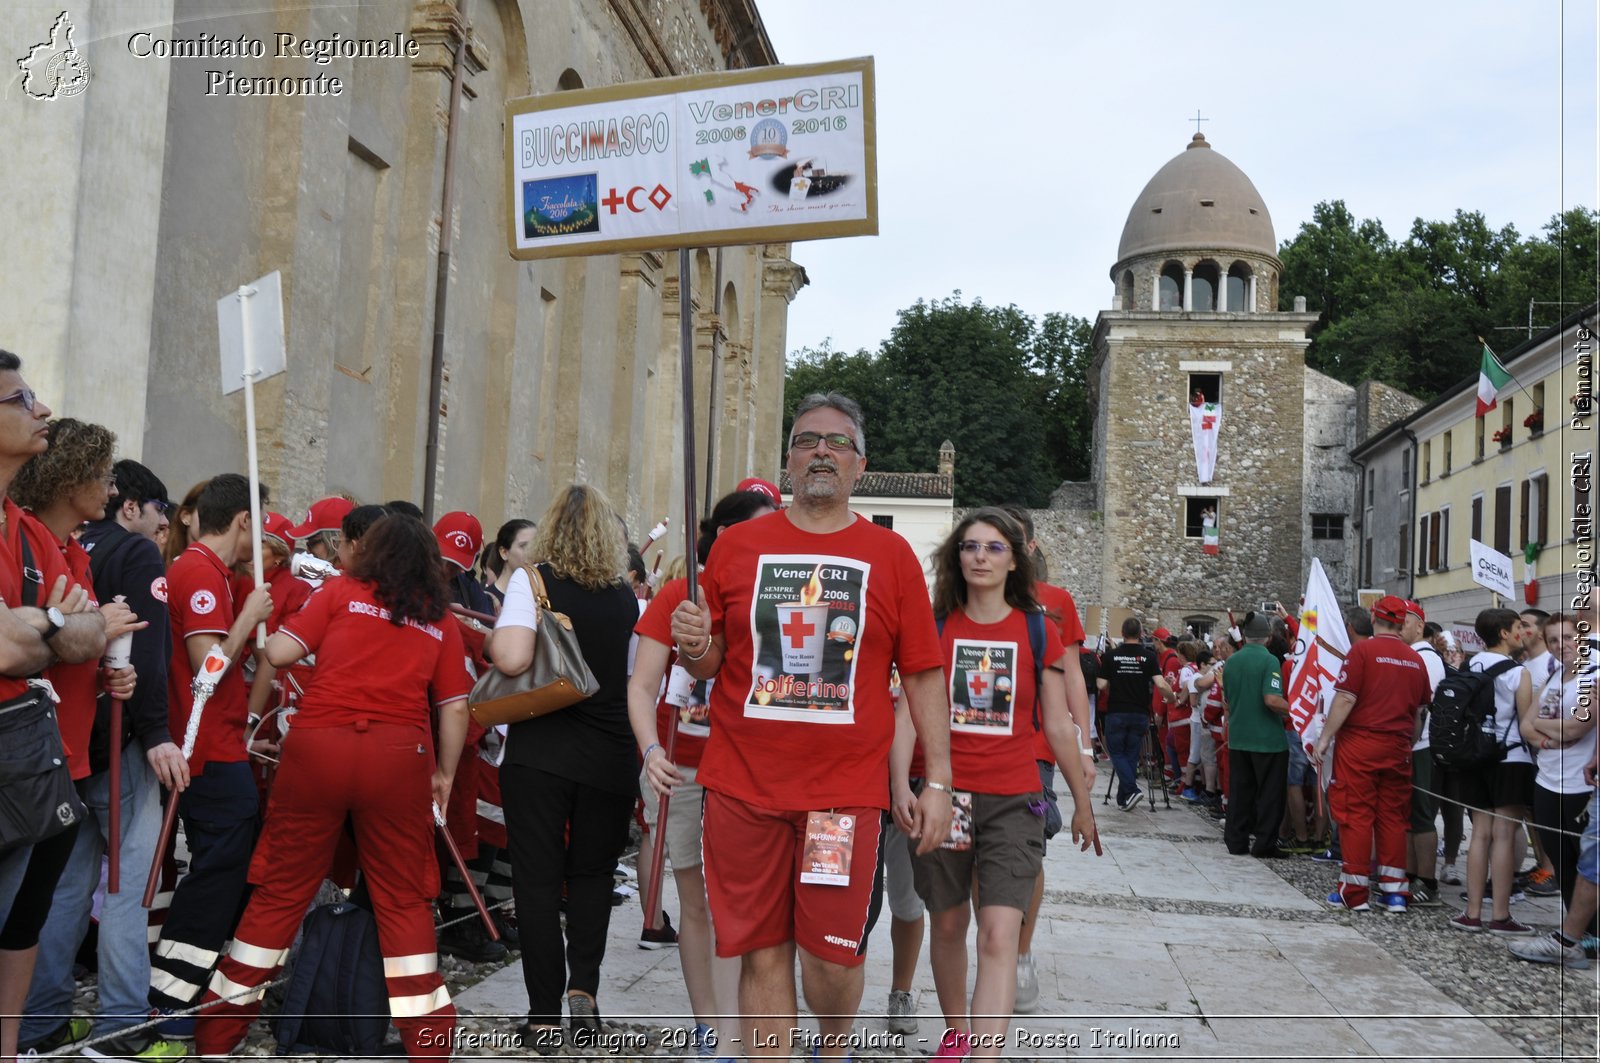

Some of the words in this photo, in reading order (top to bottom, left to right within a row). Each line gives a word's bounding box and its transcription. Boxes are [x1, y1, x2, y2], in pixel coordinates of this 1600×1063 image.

[688, 84, 859, 125] VenerCRI
[763, 128, 776, 140] 10
[792, 115, 847, 136] 2016
[521, 112, 670, 169] BUCCINASCO
[696, 126, 747, 145] 2006
[550, 209, 568, 219] 2016
[773, 567, 812, 579] Vener
[819, 568, 849, 581] CRI
[1478, 558, 1509, 581] CREMA
[823, 590, 850, 600] 2006
[349, 600, 379, 617] CROCE
[829, 601, 856, 612] 2016
[755, 674, 849, 699] Solferino
